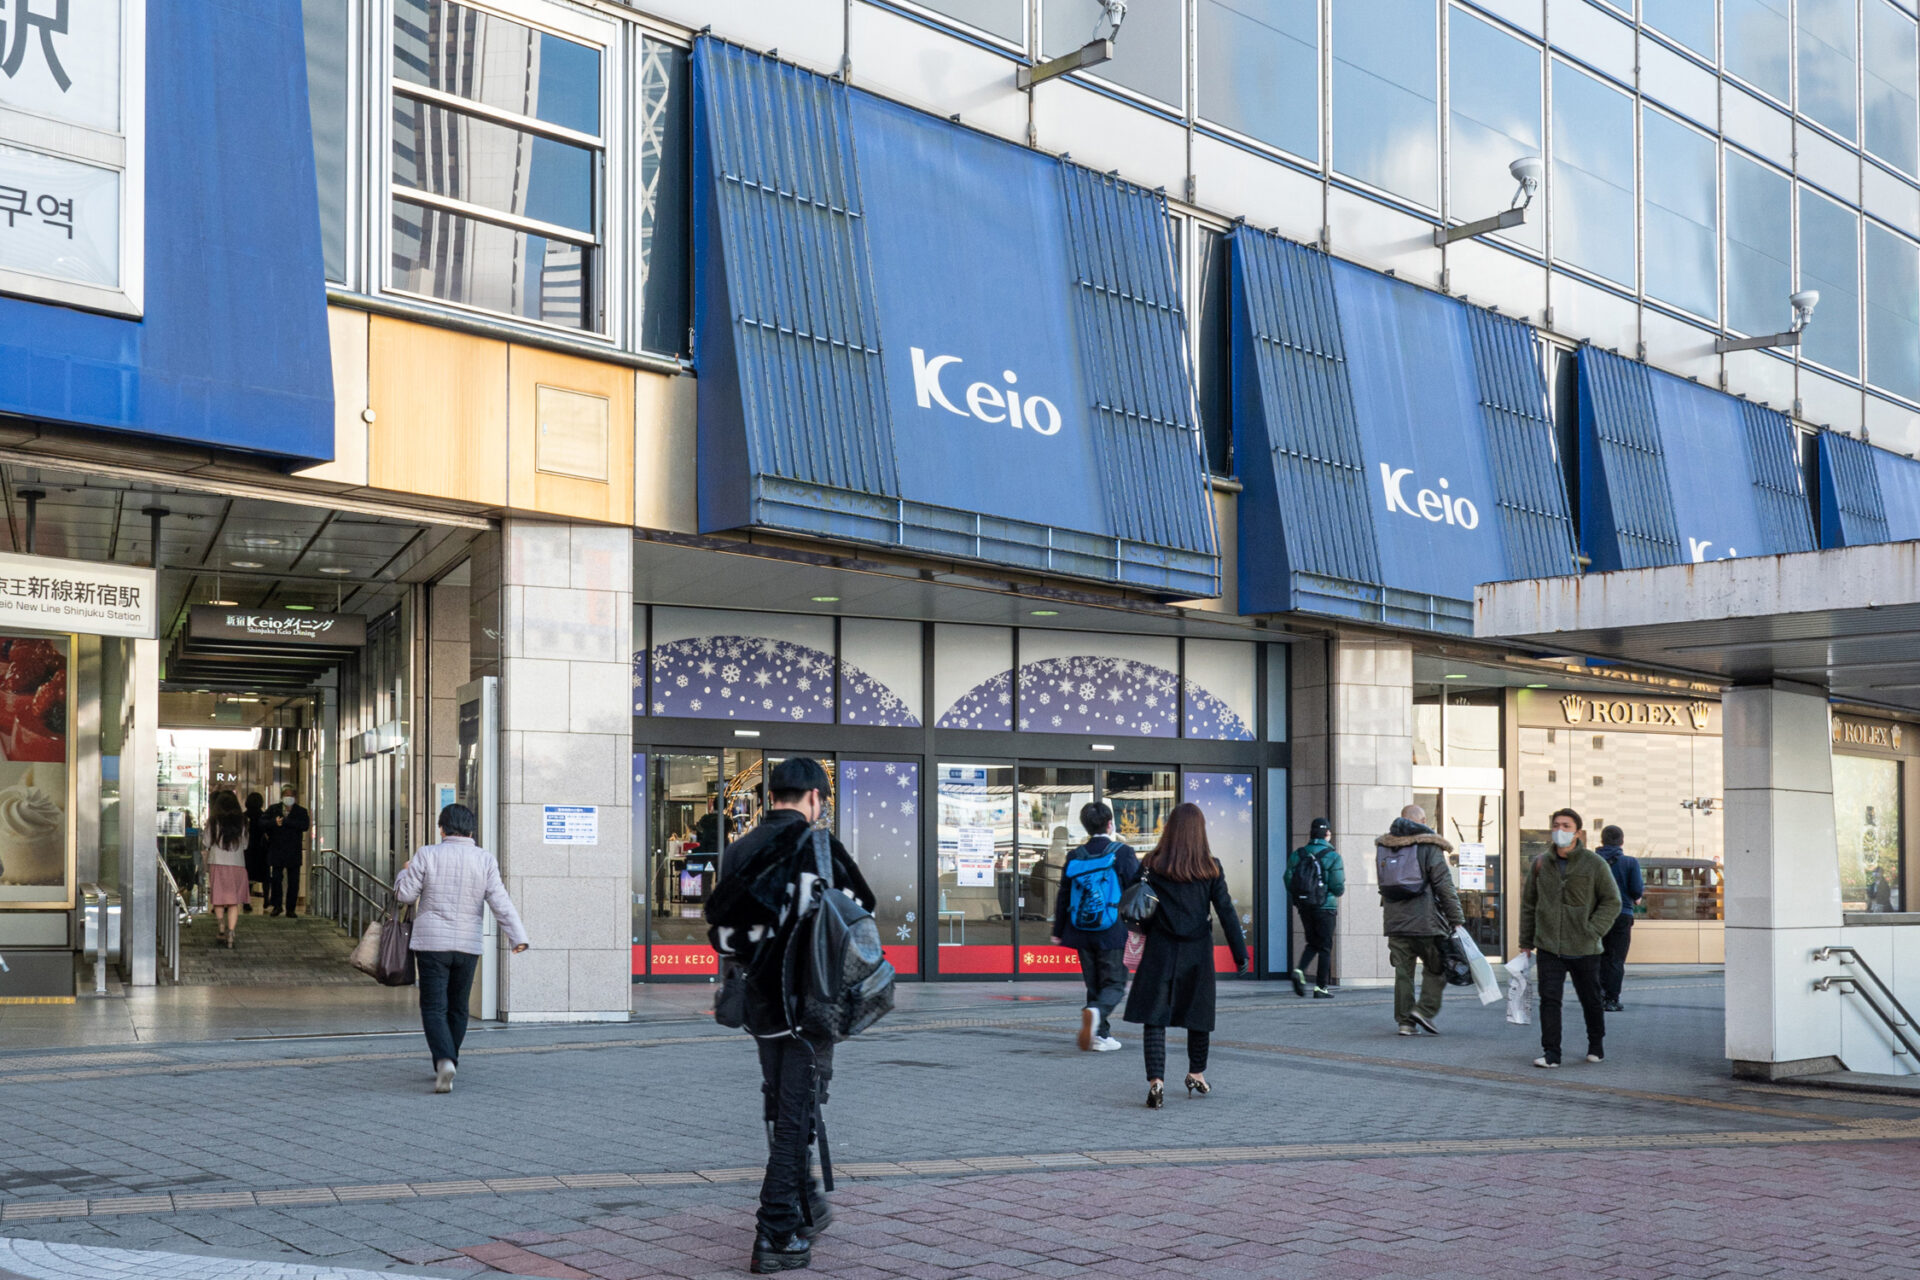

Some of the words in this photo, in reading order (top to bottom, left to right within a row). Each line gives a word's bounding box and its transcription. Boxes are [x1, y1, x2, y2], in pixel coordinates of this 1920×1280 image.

[910, 346, 1062, 436] Keio
[1379, 462, 1479, 530] Keio
[16, 601, 38, 611] New
[41, 603, 61, 614] Line
[64, 605, 105, 617] Shinjuku
[107, 609, 141, 621] Station
[1590, 701, 1684, 726] ROLEX
[1844, 722, 1889, 747] ROLEX
[652, 954, 679, 965] 2021
[685, 954, 715, 965] KEIO
[1036, 954, 1060, 964] 2021
[1064, 954, 1080, 964] KE
